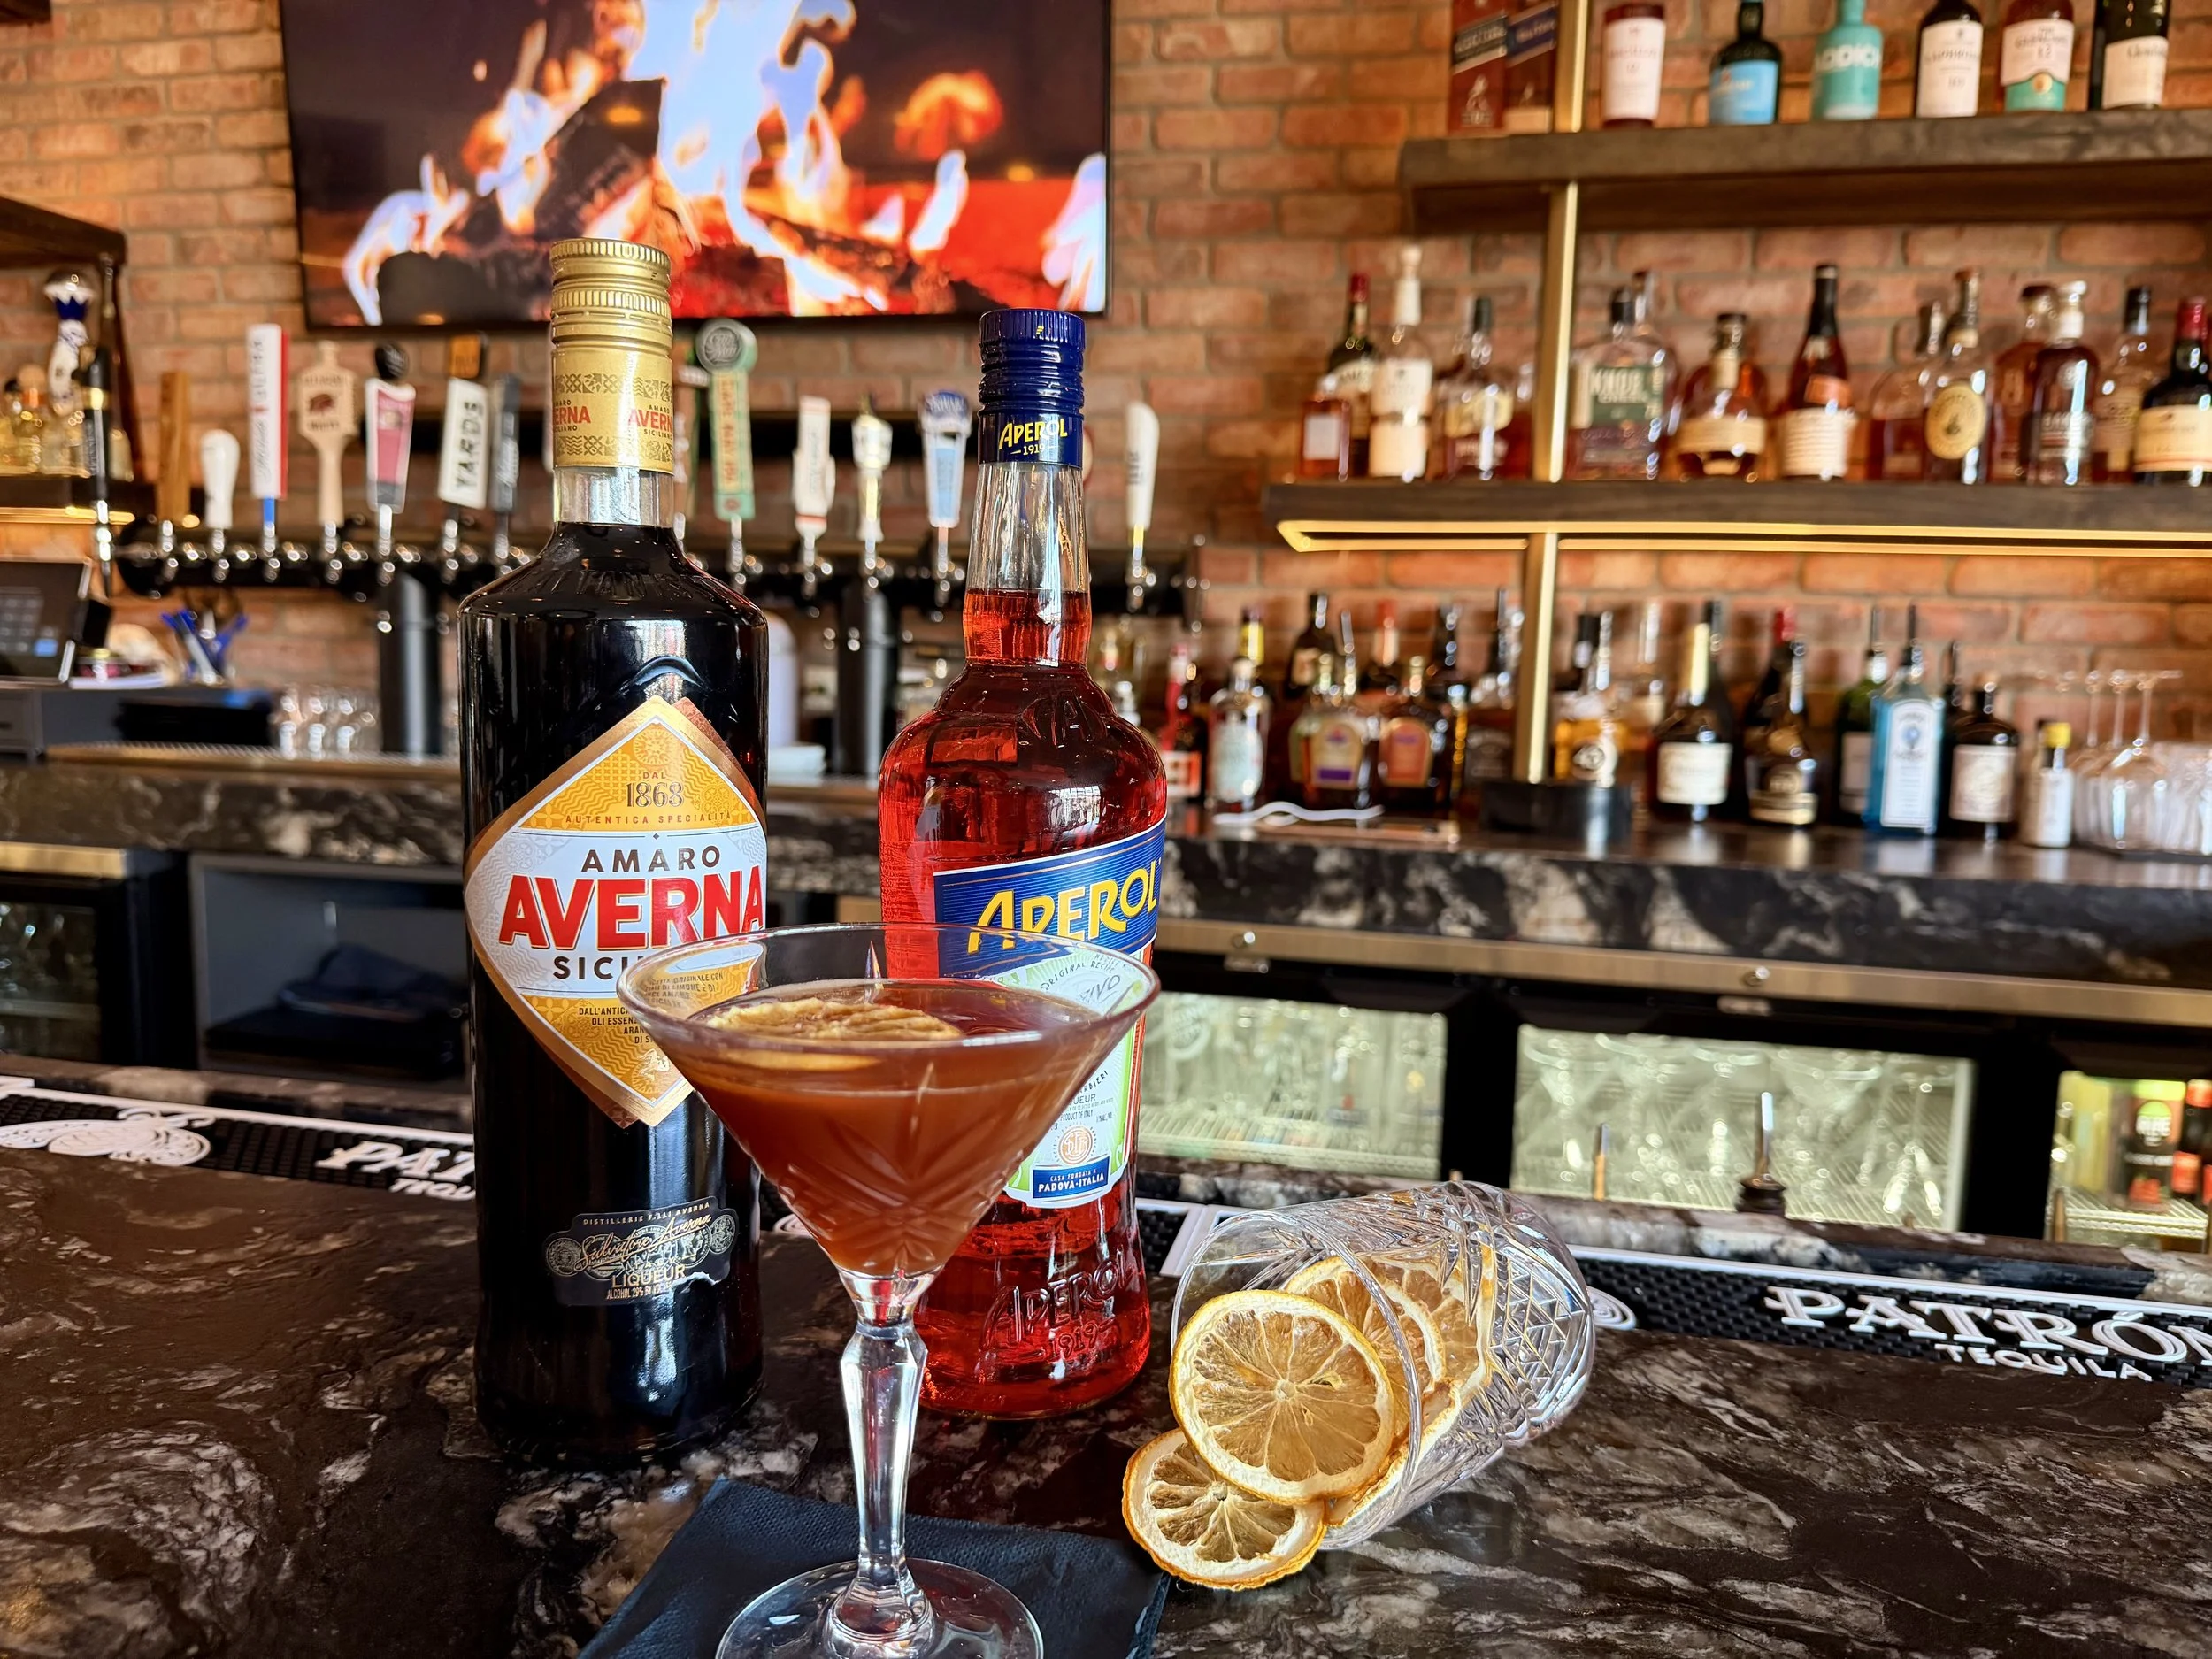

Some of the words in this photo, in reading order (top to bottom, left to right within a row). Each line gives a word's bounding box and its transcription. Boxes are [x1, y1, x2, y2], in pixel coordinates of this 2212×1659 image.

[553, 405, 592, 425] ERNA
[628, 408, 672, 434] AVERN
[455, 401, 485, 488] YARDS
[998, 418, 1068, 450] APEROL
[1023, 444, 1046, 457] 1919
[642, 772, 667, 780] DAL
[626, 781, 685, 809] 1868
[565, 815, 649, 825] AUTENTICA
[657, 810, 732, 824] SPECIALITÀ
[580, 845, 721, 872] AMARO
[497, 864, 764, 952] AVERNA
[966, 858, 1157, 955] APEROL
[672, 983, 701, 992] LIMONE
[710, 972, 724, 982] CON
[1041, 961, 1086, 991] ORIGINAL
[1079, 1070, 1109, 1094] RBIERI
[1071, 1094, 1096, 1105] UEUR
[1050, 1173, 1065, 1182] CASA
[583, 1216, 644, 1226] DISTILLERIE
[675, 1202, 710, 1217] AVERNA
[651, 1214, 713, 1249] Averna
[611, 1264, 686, 1289] LIQUEUR
[606, 1287, 632, 1300] ALCOHOL
[632, 1286, 644, 1297] 29%
[980, 1245, 1133, 1351] APEROL
[1049, 1318, 1099, 1361] 1919
[1934, 1342, 2153, 1382] TEQUILA
